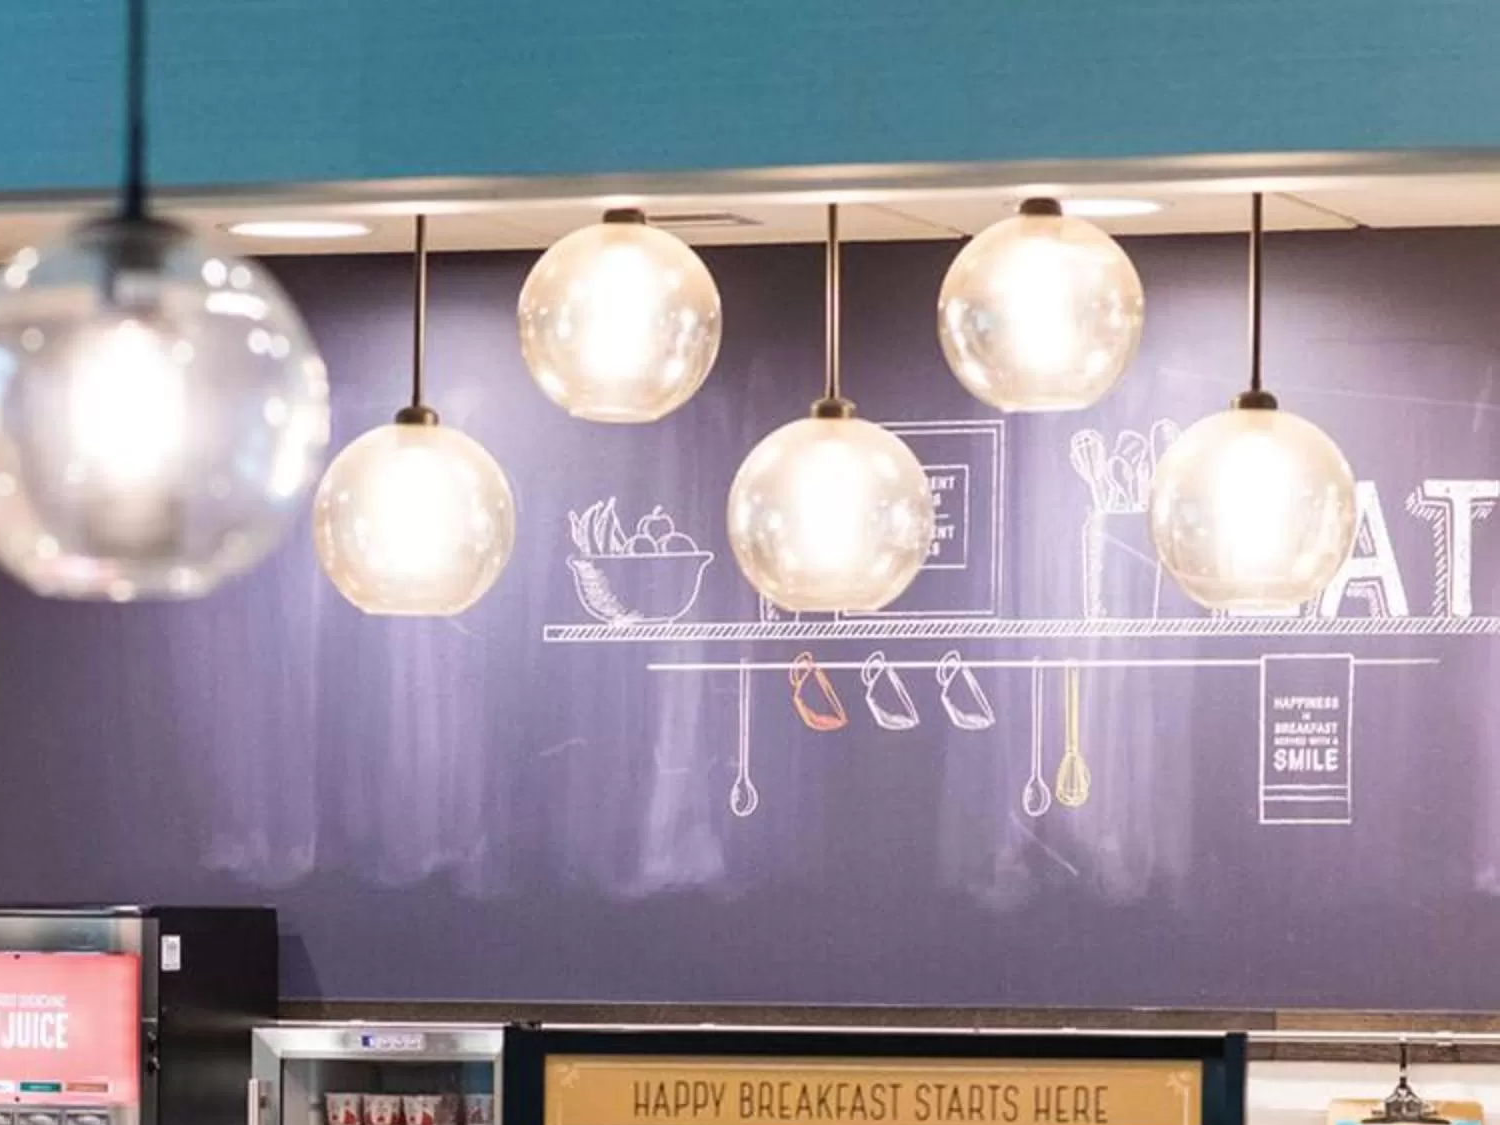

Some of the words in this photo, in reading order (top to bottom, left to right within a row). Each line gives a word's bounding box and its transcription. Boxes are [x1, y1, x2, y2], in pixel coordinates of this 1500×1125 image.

[1273, 747, 1339, 772] SMILE
[0, 1011, 69, 1050] JUICE
[633, 1080, 727, 1119] HAPPY
[739, 1080, 903, 1121] BREAKFAST
[915, 1083, 1020, 1123] STARTS
[1033, 1084, 1109, 1125] HERE
